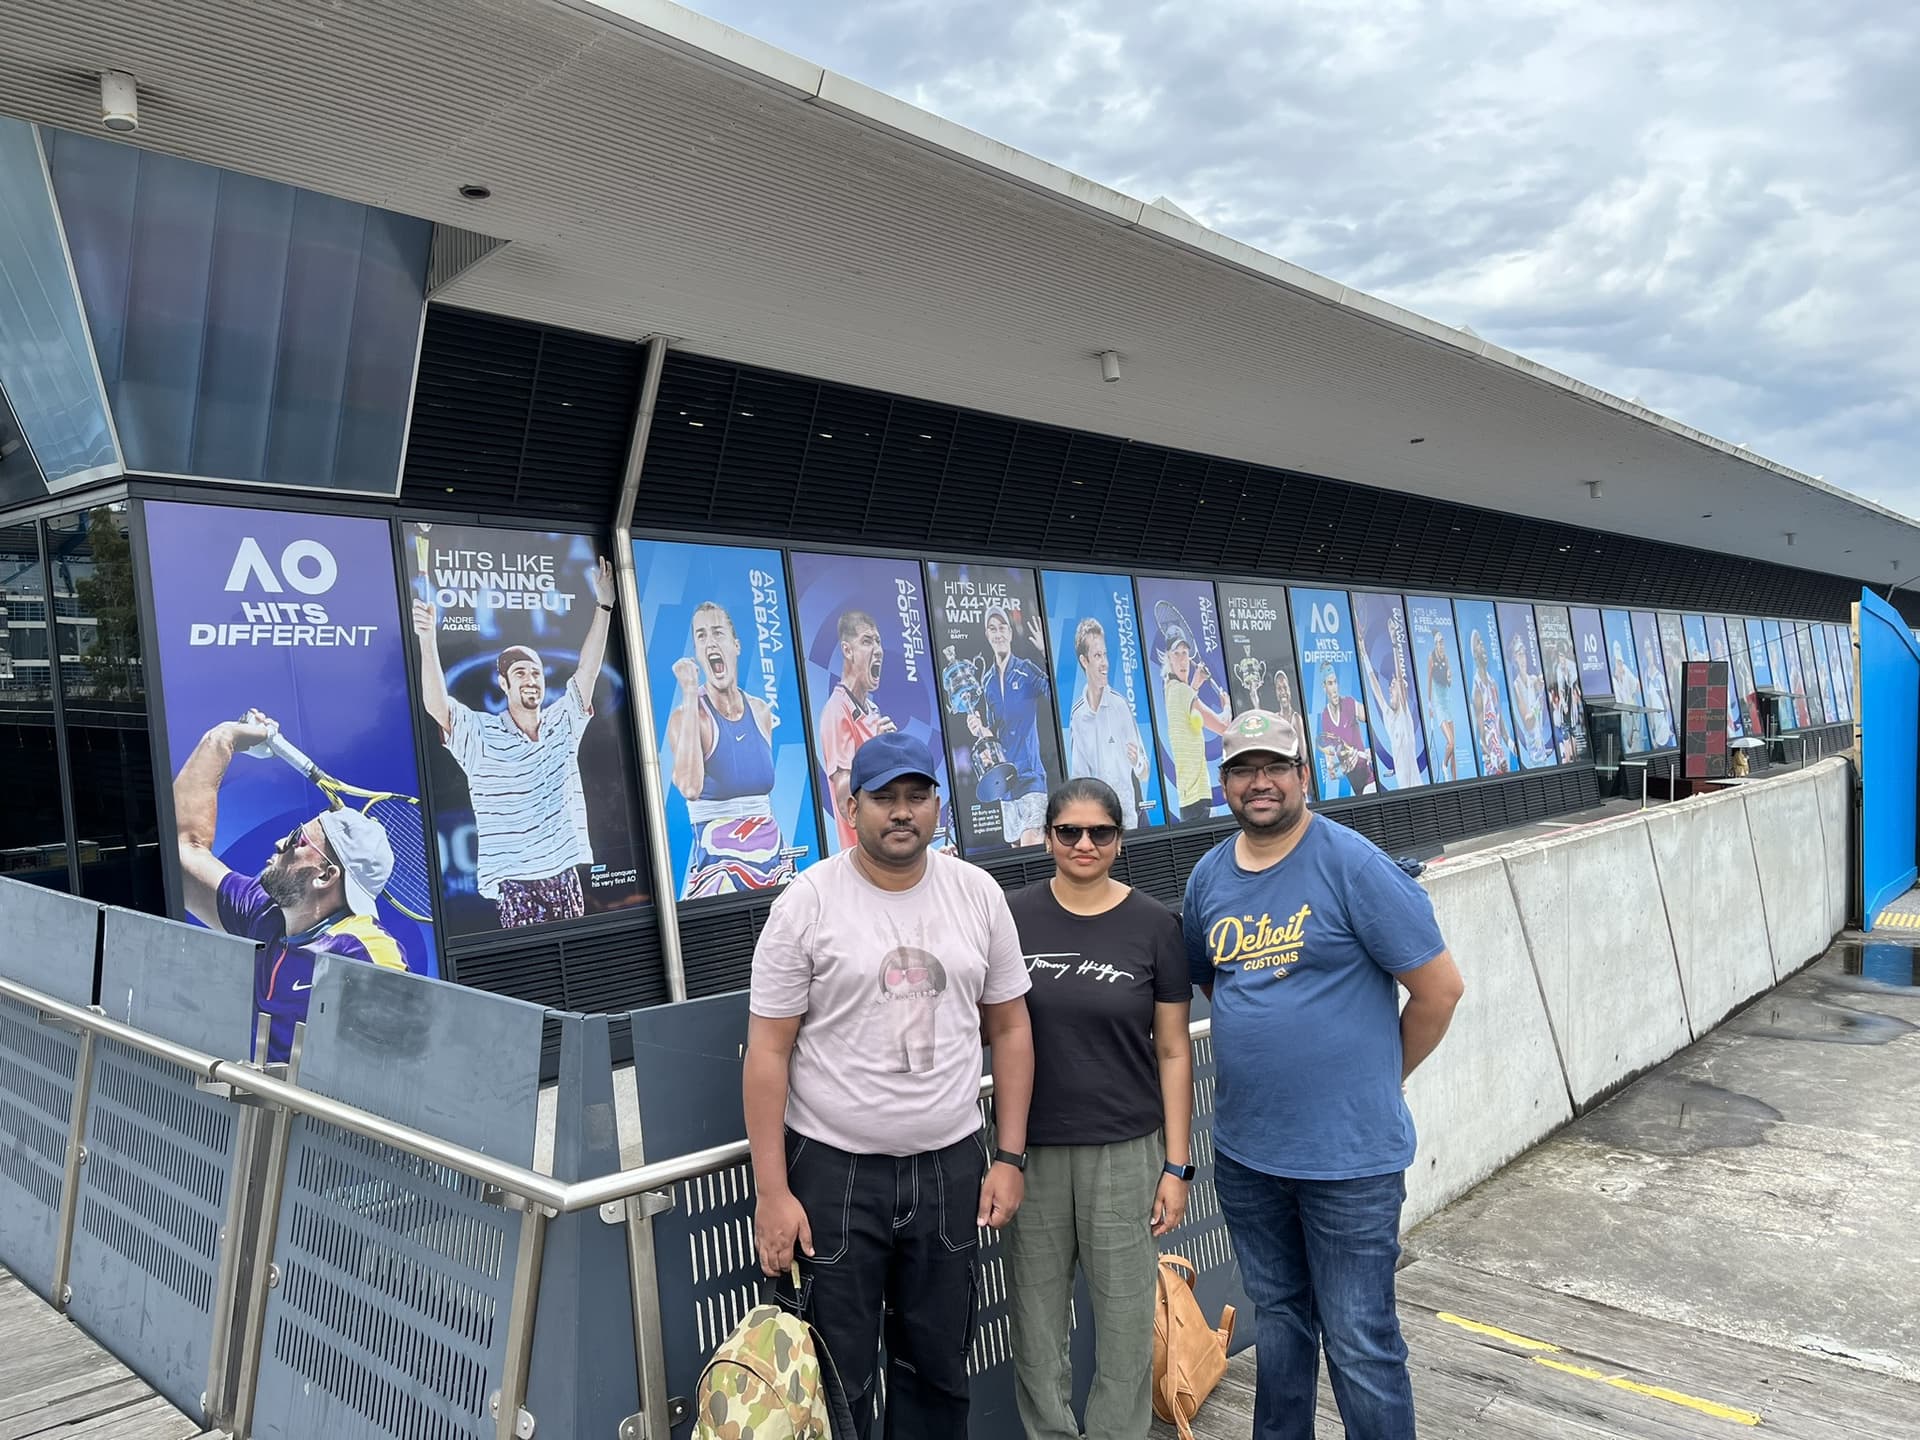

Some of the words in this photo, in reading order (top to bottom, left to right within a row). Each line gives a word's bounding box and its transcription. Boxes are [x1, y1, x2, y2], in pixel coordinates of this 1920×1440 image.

[224, 537, 338, 595] AO
[435, 549, 493, 570] HITS
[502, 553, 554, 573] LIKE
[435, 569, 555, 591] WINNING
[944, 581, 975, 595] HITS
[978, 583, 1007, 597] LIKE
[436, 589, 478, 608] ON
[487, 591, 575, 610] DEBUT
[946, 595, 957, 608] A
[960, 596, 1021, 610] 44-YEAR
[1228, 597, 1248, 608] HITS
[1249, 598, 1268, 609] LIKE
[241, 602, 329, 624] HITS
[762, 571, 783, 652] ARYNA
[905, 580, 924, 654] ALEXEI
[945, 609, 982, 623] WAIT
[1230, 608, 1236, 618] 4
[1237, 609, 1277, 620] MAJORS
[1311, 602, 1339, 634] AO
[190, 624, 378, 646] DIFFERENT
[442, 623, 481, 631] AGASSI
[895, 578, 918, 682] POPYRIN
[1121, 593, 1138, 670] THOMAS
[1199, 596, 1212, 653] MOLIK
[1205, 598, 1218, 650] ALICIA
[1230, 620, 1240, 630] IN
[1242, 620, 1249, 630] A
[1250, 620, 1272, 631] ROW
[750, 569, 781, 729] SABALENKA
[1113, 591, 1137, 717] JOHANSSON
[1315, 639, 1339, 650] HITS
[1304, 651, 1353, 663] DIFFERENT
[591, 872, 609, 881] Agassi
[610, 869, 637, 878] conquers
[1209, 904, 1311, 966] Detroit
[1243, 951, 1299, 970] CUSTOMS
